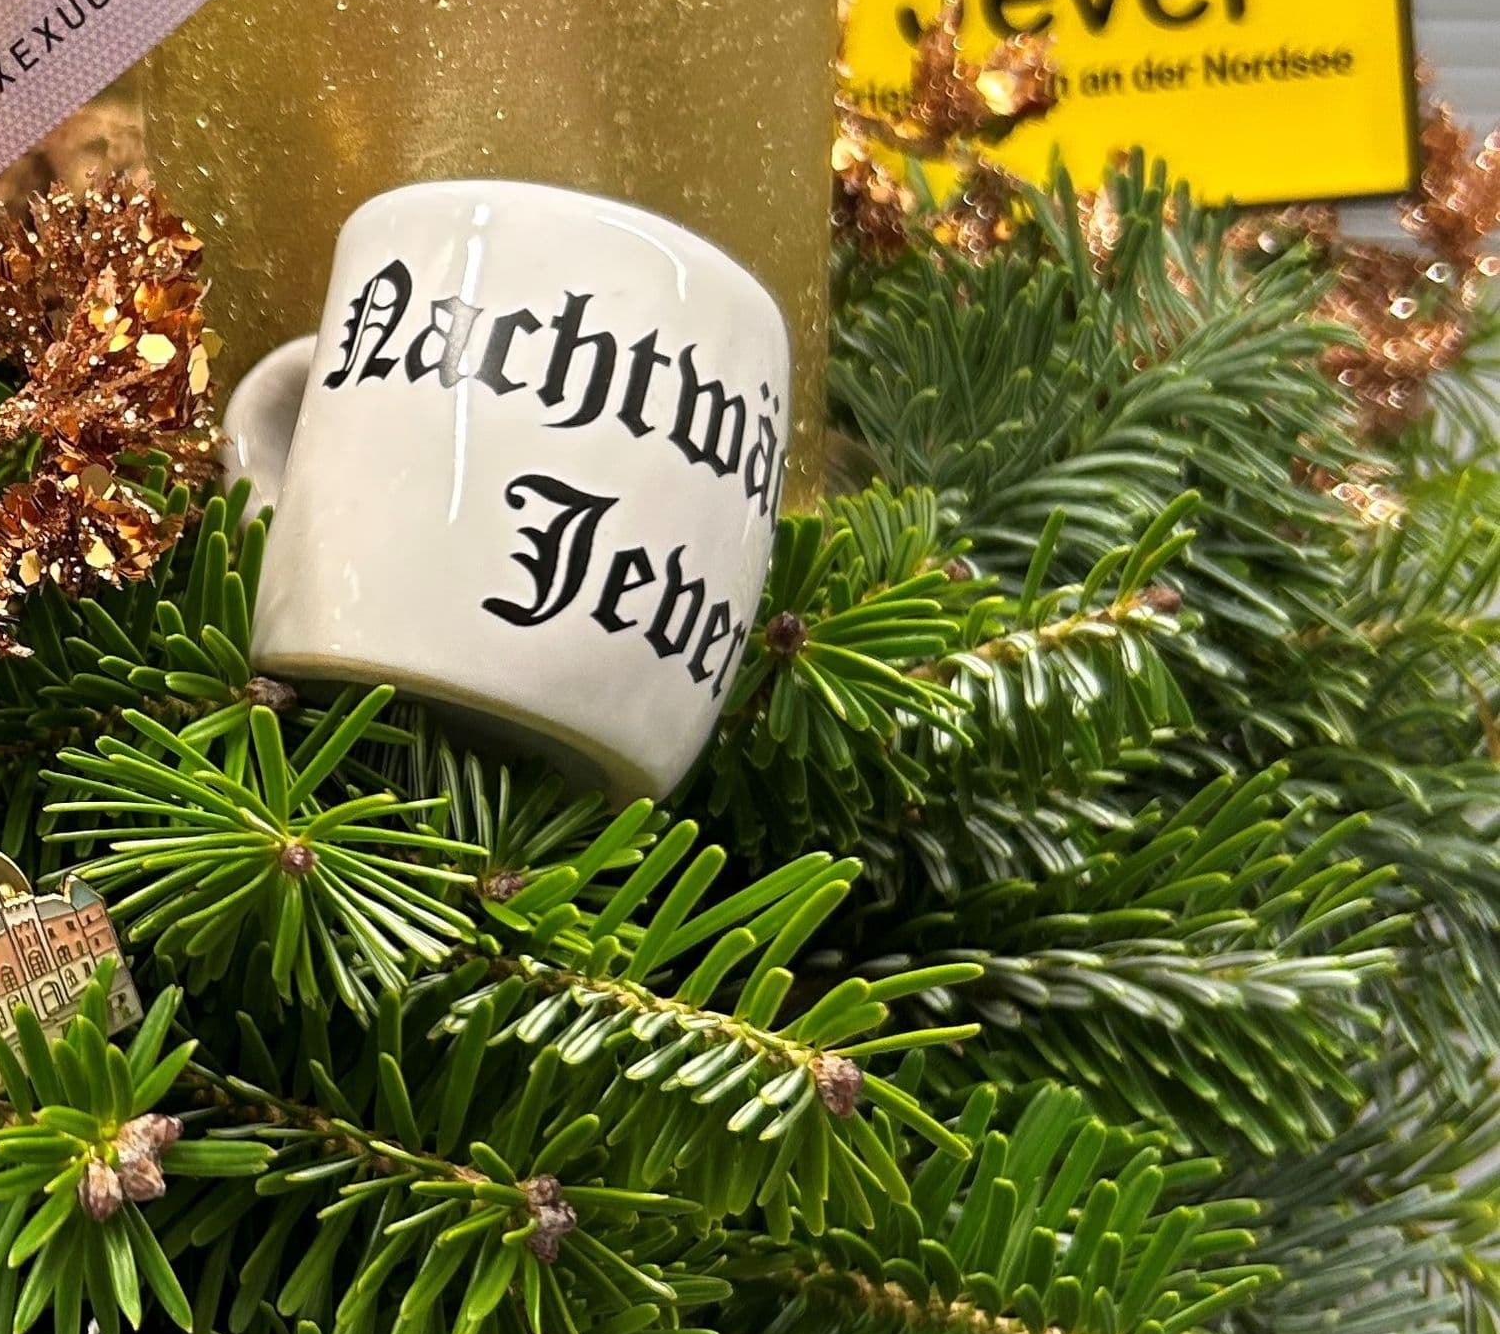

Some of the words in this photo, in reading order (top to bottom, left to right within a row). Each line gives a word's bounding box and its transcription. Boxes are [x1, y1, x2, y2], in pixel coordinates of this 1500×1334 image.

[1079, 70, 1123, 99] an
[1132, 55, 1197, 92] der
[1202, 45, 1357, 87] Nordsee
[323, 258, 786, 535] Nachtwä
